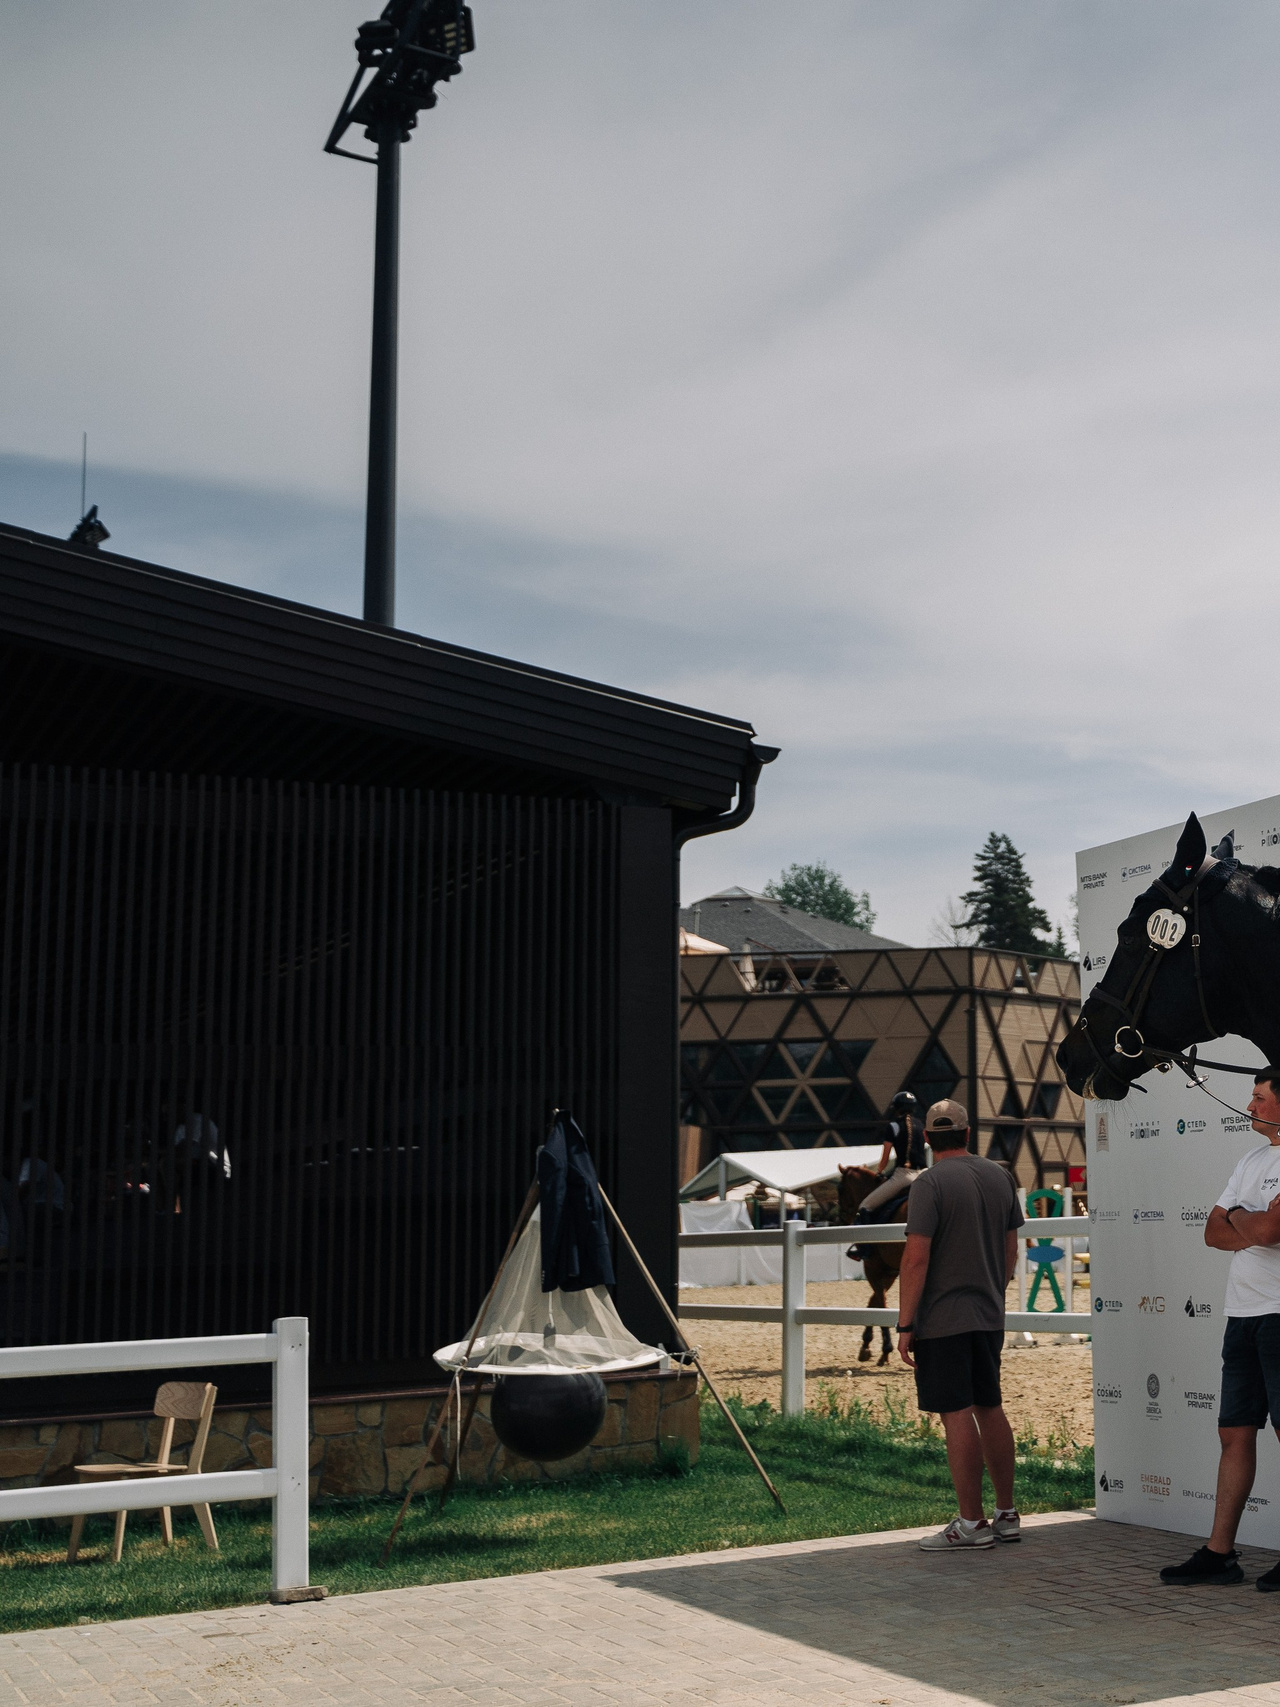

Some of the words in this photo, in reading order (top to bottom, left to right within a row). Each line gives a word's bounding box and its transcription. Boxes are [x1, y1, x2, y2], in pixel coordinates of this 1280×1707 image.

[1080, 875, 1092, 883] MTS
[1092, 872, 1108, 881] BANK
[1083, 880, 1105, 890] PRIVATE
[1151, 914, 1178, 942] 002
[1092, 956, 1107, 966] LIRS
[1187, 1120, 1206, 1128] СТЕПЬ
[1221, 1117, 1234, 1125] MTS
[1235, 1115, 1250, 1124] BAN
[1224, 1124, 1250, 1133] PRIVATE
[1181, 1211, 1208, 1221] COSMOS
[1195, 1304, 1211, 1313] LIRS
[1097, 1389, 1122, 1398] COSMOS
[1184, 1391, 1198, 1400] MTS
[1198, 1392, 1216, 1401] BANK
[1187, 1401, 1213, 1410] PRIVATE
[1109, 1479, 1124, 1489] LIRS
[1140, 1473, 1171, 1486] EMERALD
[1141, 1484, 1170, 1497] STABLES
[1182, 1489, 1194, 1498] BN
